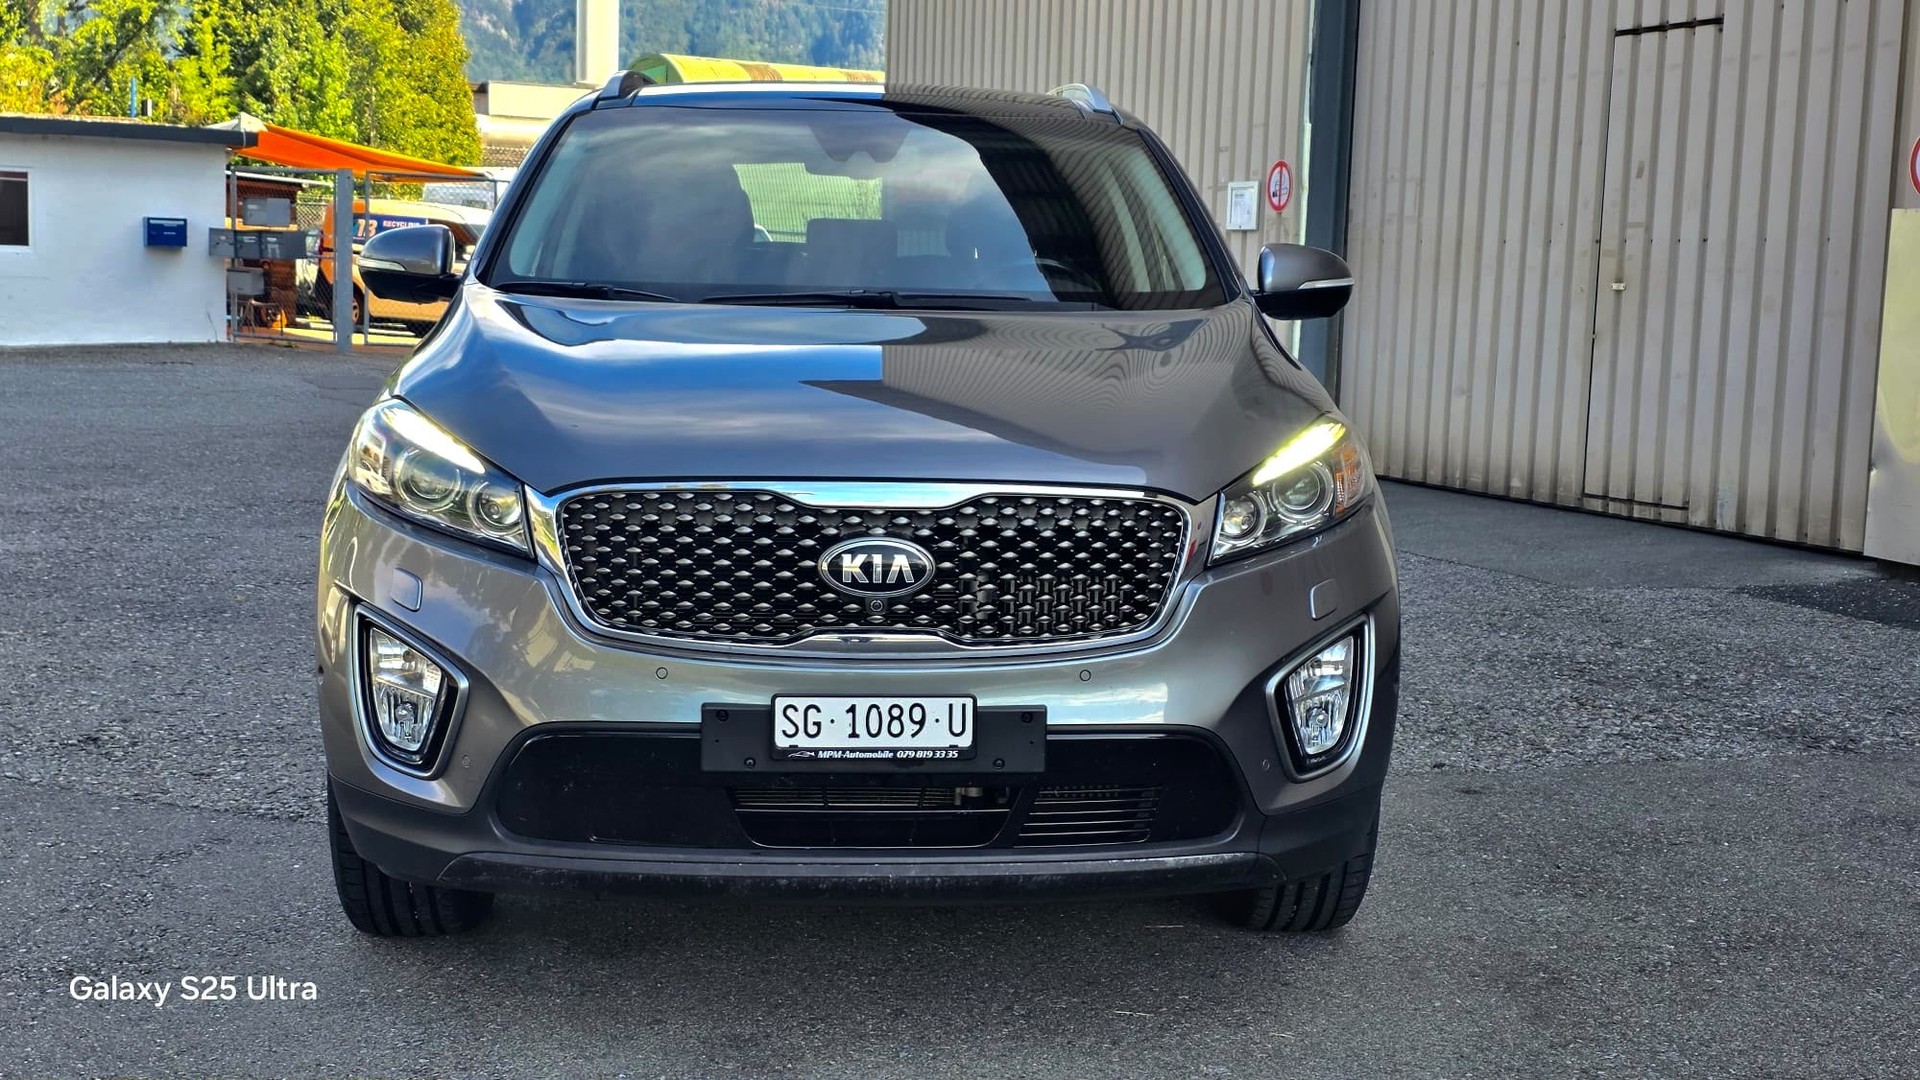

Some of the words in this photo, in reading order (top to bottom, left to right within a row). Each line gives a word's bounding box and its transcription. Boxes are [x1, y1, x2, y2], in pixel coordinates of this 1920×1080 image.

[841, 553, 915, 583] KIA
[817, 750, 894, 759] MPM-Automobile
[896, 750, 915, 759] 079
[915, 750, 933, 759] 819
[933, 750, 946, 759] 33
[946, 750, 959, 759] 35
